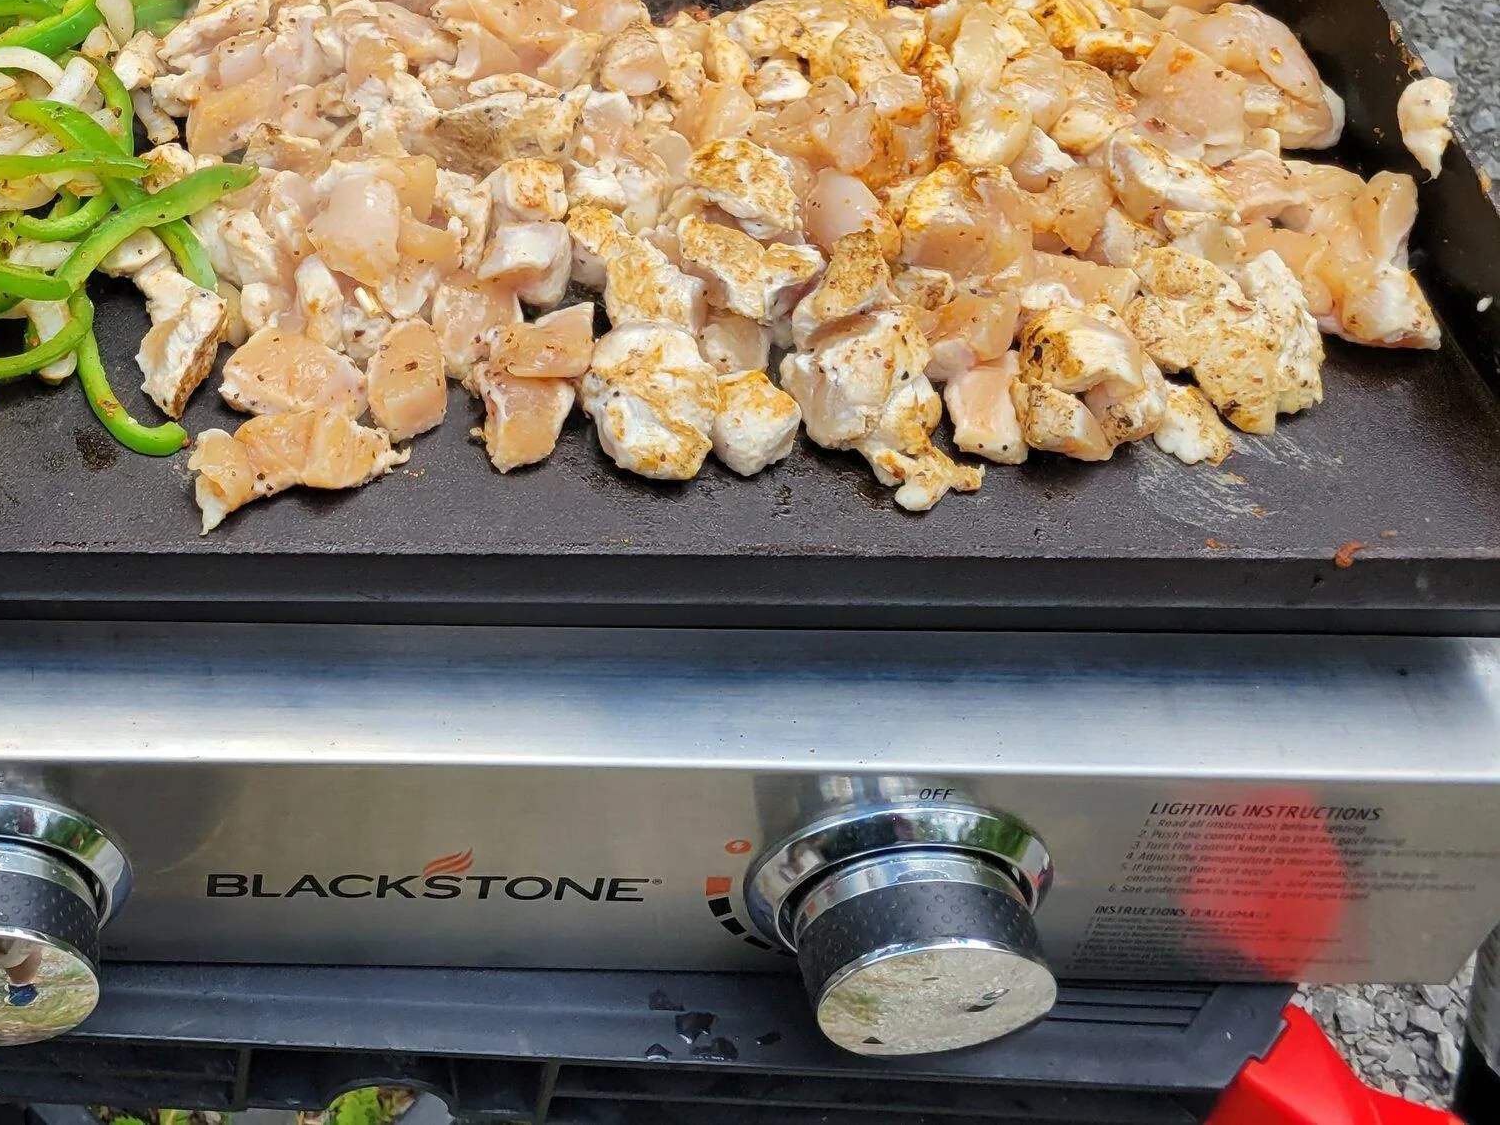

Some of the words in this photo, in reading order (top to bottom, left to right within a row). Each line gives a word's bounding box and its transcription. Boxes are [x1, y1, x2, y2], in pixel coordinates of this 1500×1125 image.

[919, 788, 955, 801] OFF
[1149, 802, 1238, 818] LIGHTING
[1241, 804, 1384, 821] INSTRUCTIONS
[1203, 831, 1247, 841] control
[1137, 851, 1176, 863] Adjust
[205, 873, 651, 903] BLACKSTONE
[1094, 905, 1188, 917] INSTRUCTIONS
